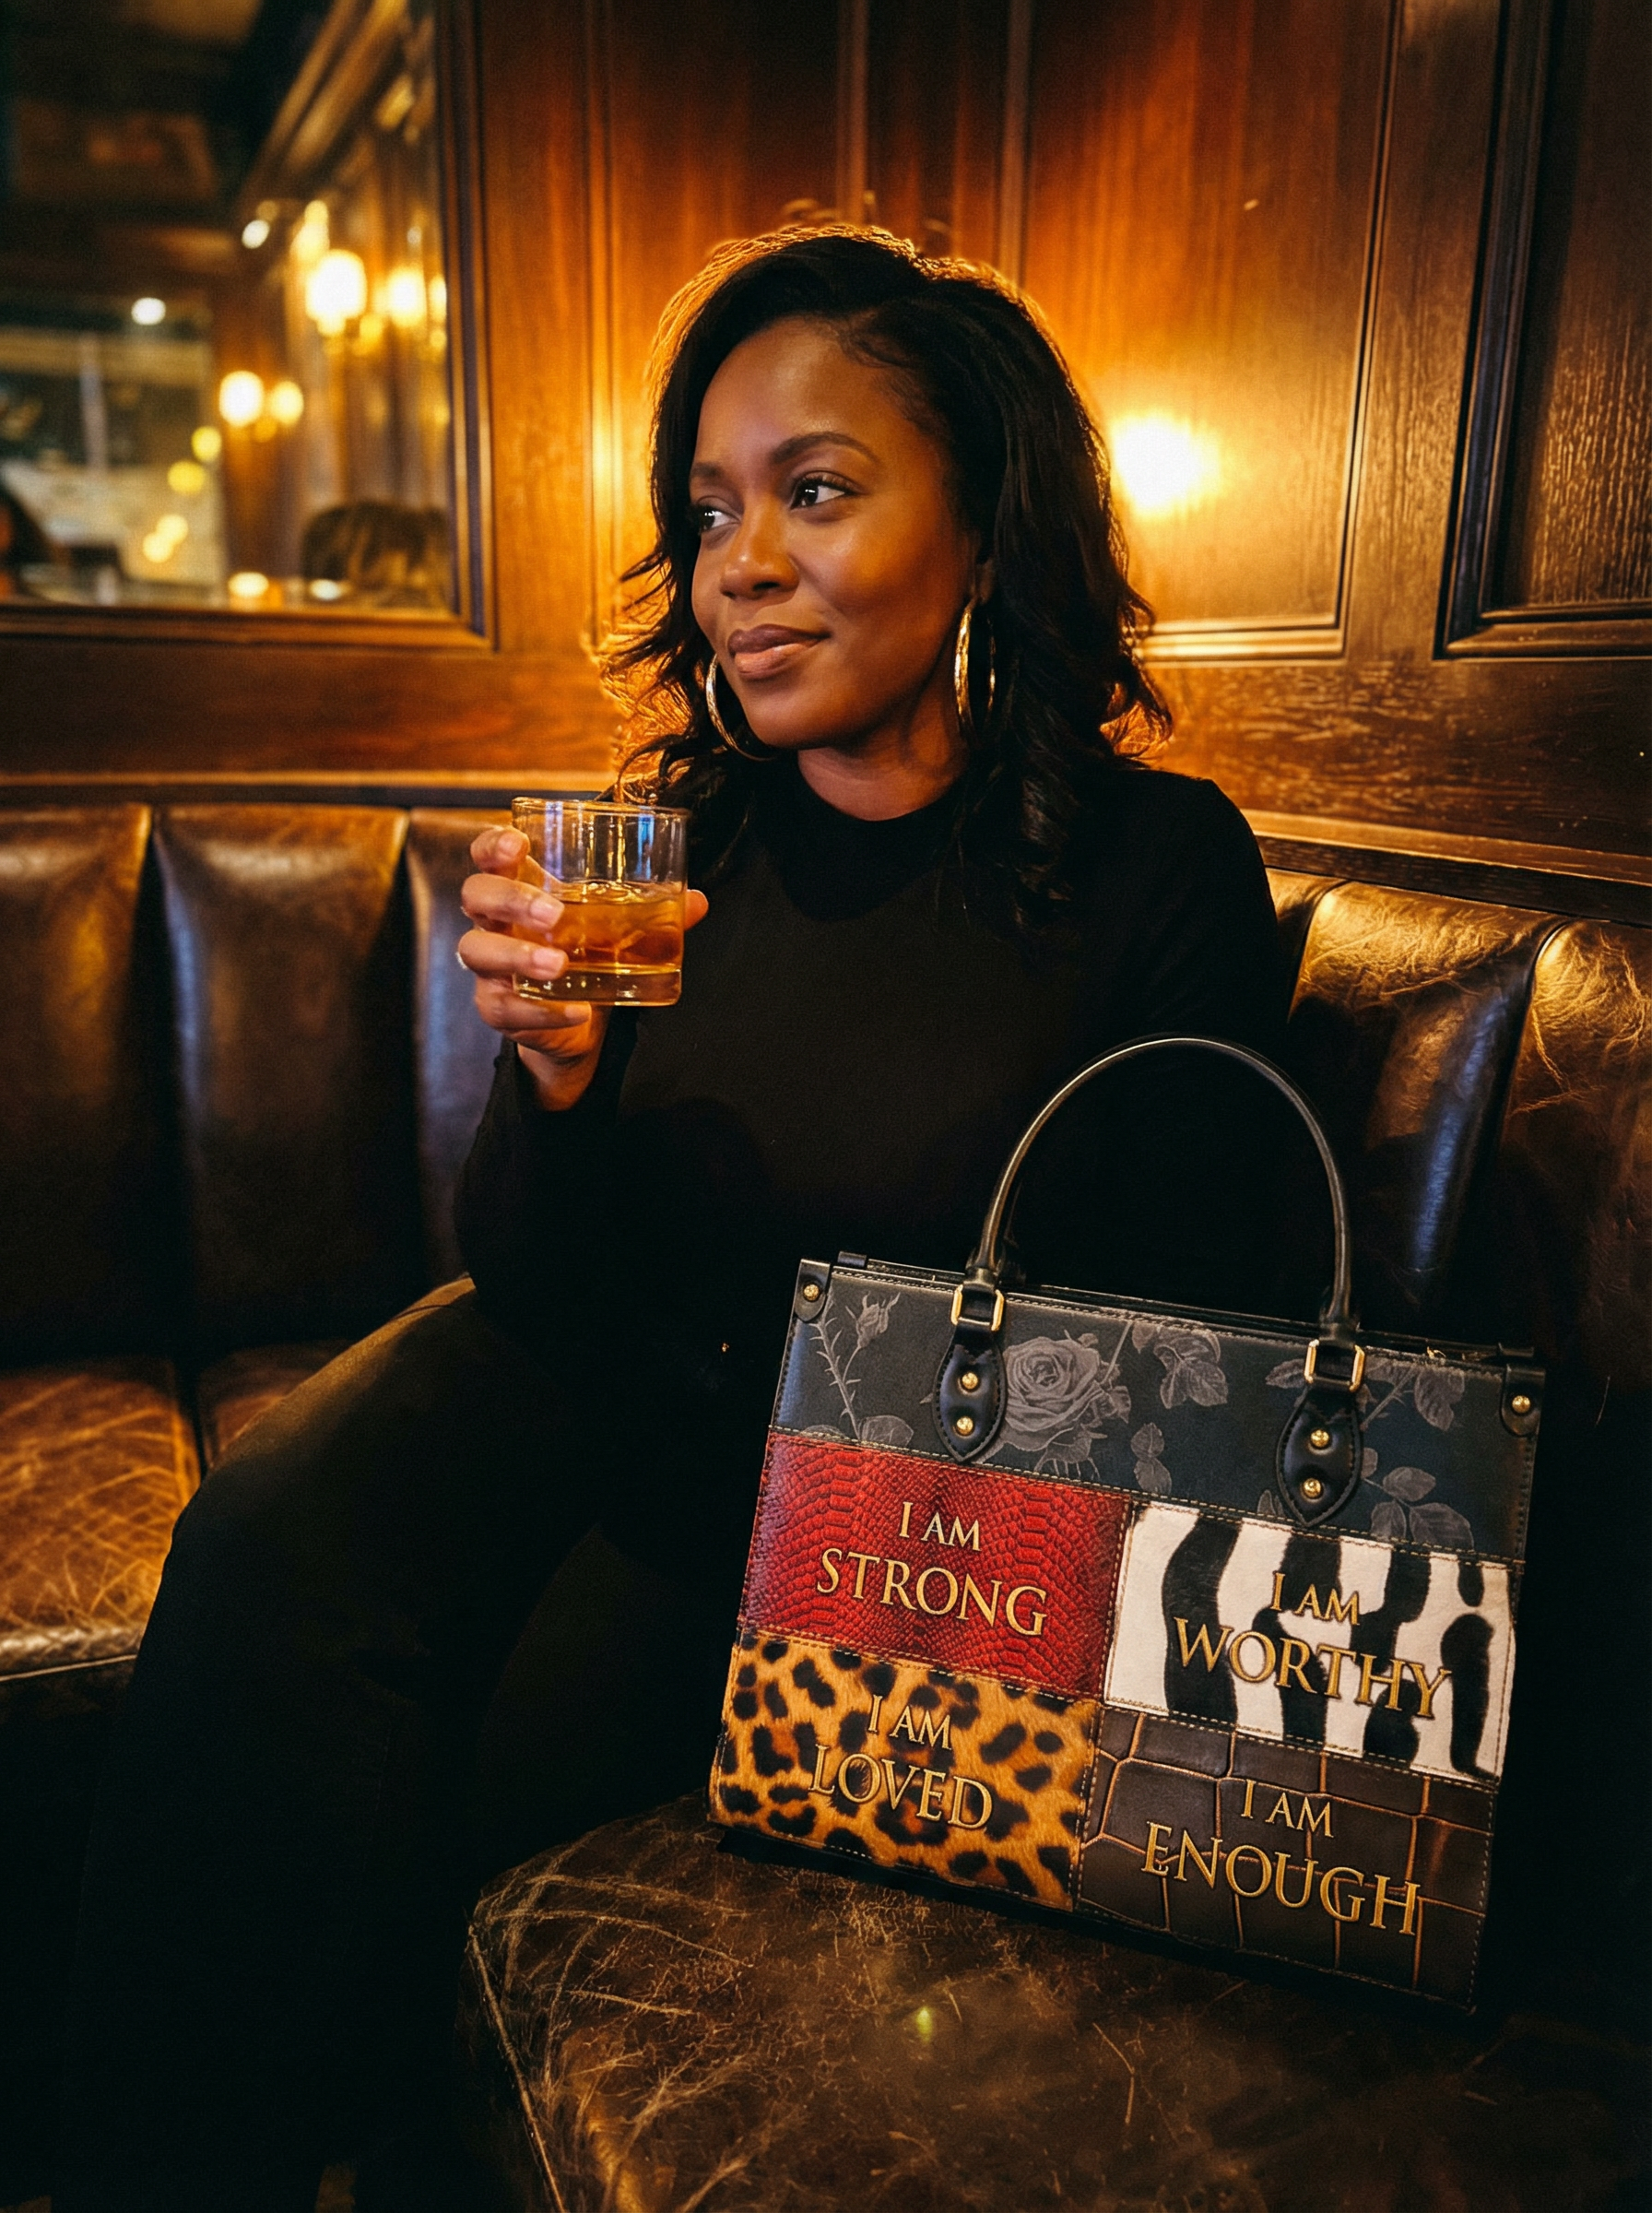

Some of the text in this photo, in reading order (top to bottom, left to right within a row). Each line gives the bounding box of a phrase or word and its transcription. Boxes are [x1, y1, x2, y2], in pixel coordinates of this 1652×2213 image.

[898, 1500, 982, 1552] I AM
[816, 1548, 1048, 1637] STRONG
[1270, 1571, 1362, 1627] I AM
[1174, 1617, 1453, 1720] WORTHY
[867, 1695, 953, 1751] I AM
[808, 1744, 993, 1831] LOVED
[1240, 1780, 1335, 1838] I AM
[1140, 1821, 1422, 1936] ENOUGH
